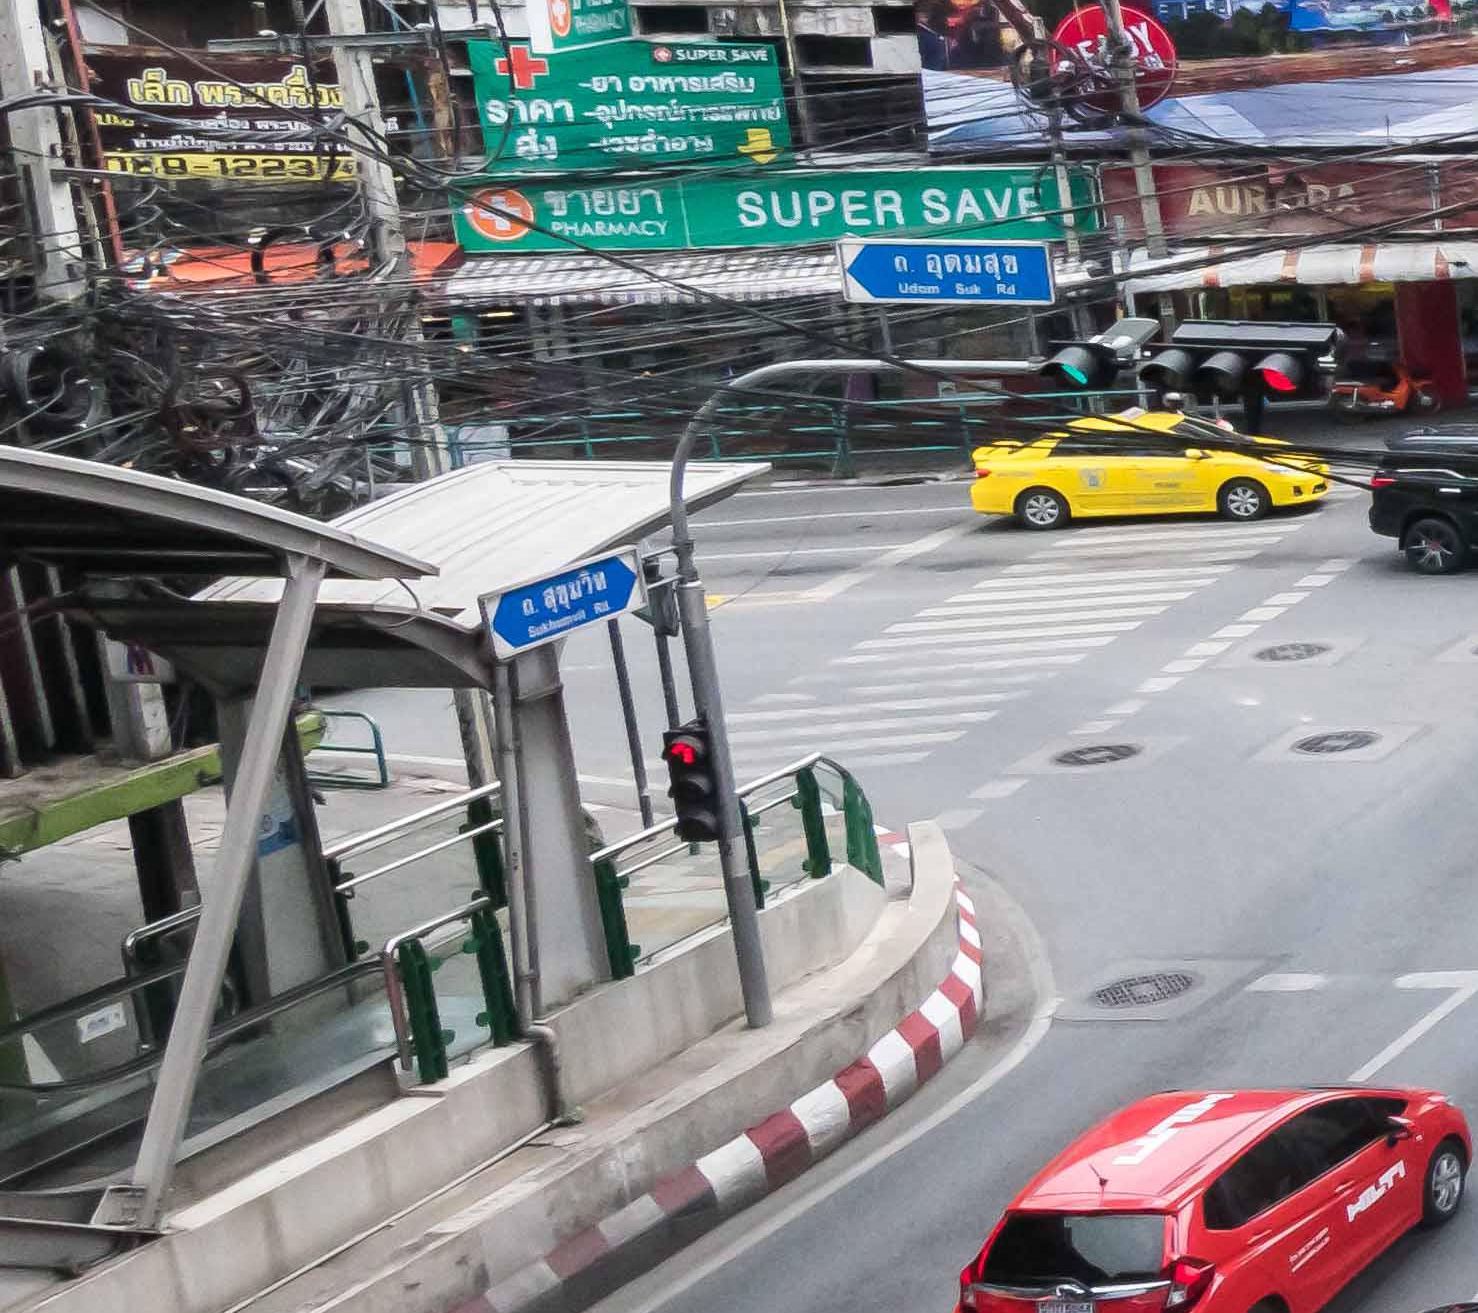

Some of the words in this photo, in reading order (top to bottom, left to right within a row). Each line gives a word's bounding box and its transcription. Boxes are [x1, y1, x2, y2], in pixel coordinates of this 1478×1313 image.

[676, 48, 730, 62] SUPER
[732, 48, 769, 62] SAVE
[127, 67, 194, 107] เล็ก
[629, 73, 756, 94] อาหารเสริม
[485, 97, 574, 124] ราคา
[515, 129, 558, 159] ส่ง
[543, 189, 664, 217] ขายยา
[737, 190, 901, 229] SUPER
[922, 187, 1047, 226] SAVE
[551, 221, 668, 238] PHARMACY
[926, 251, 1019, 284] อุดมสุข
[898, 282, 940, 297] Udom
[955, 283, 982, 297] Suk
[522, 597, 539, 617] ถ.
[543, 570, 607, 613] สุขุมวิท
[528, 609, 587, 638] Sukhumvit
[1346, 1160, 1407, 1223] HILTI
